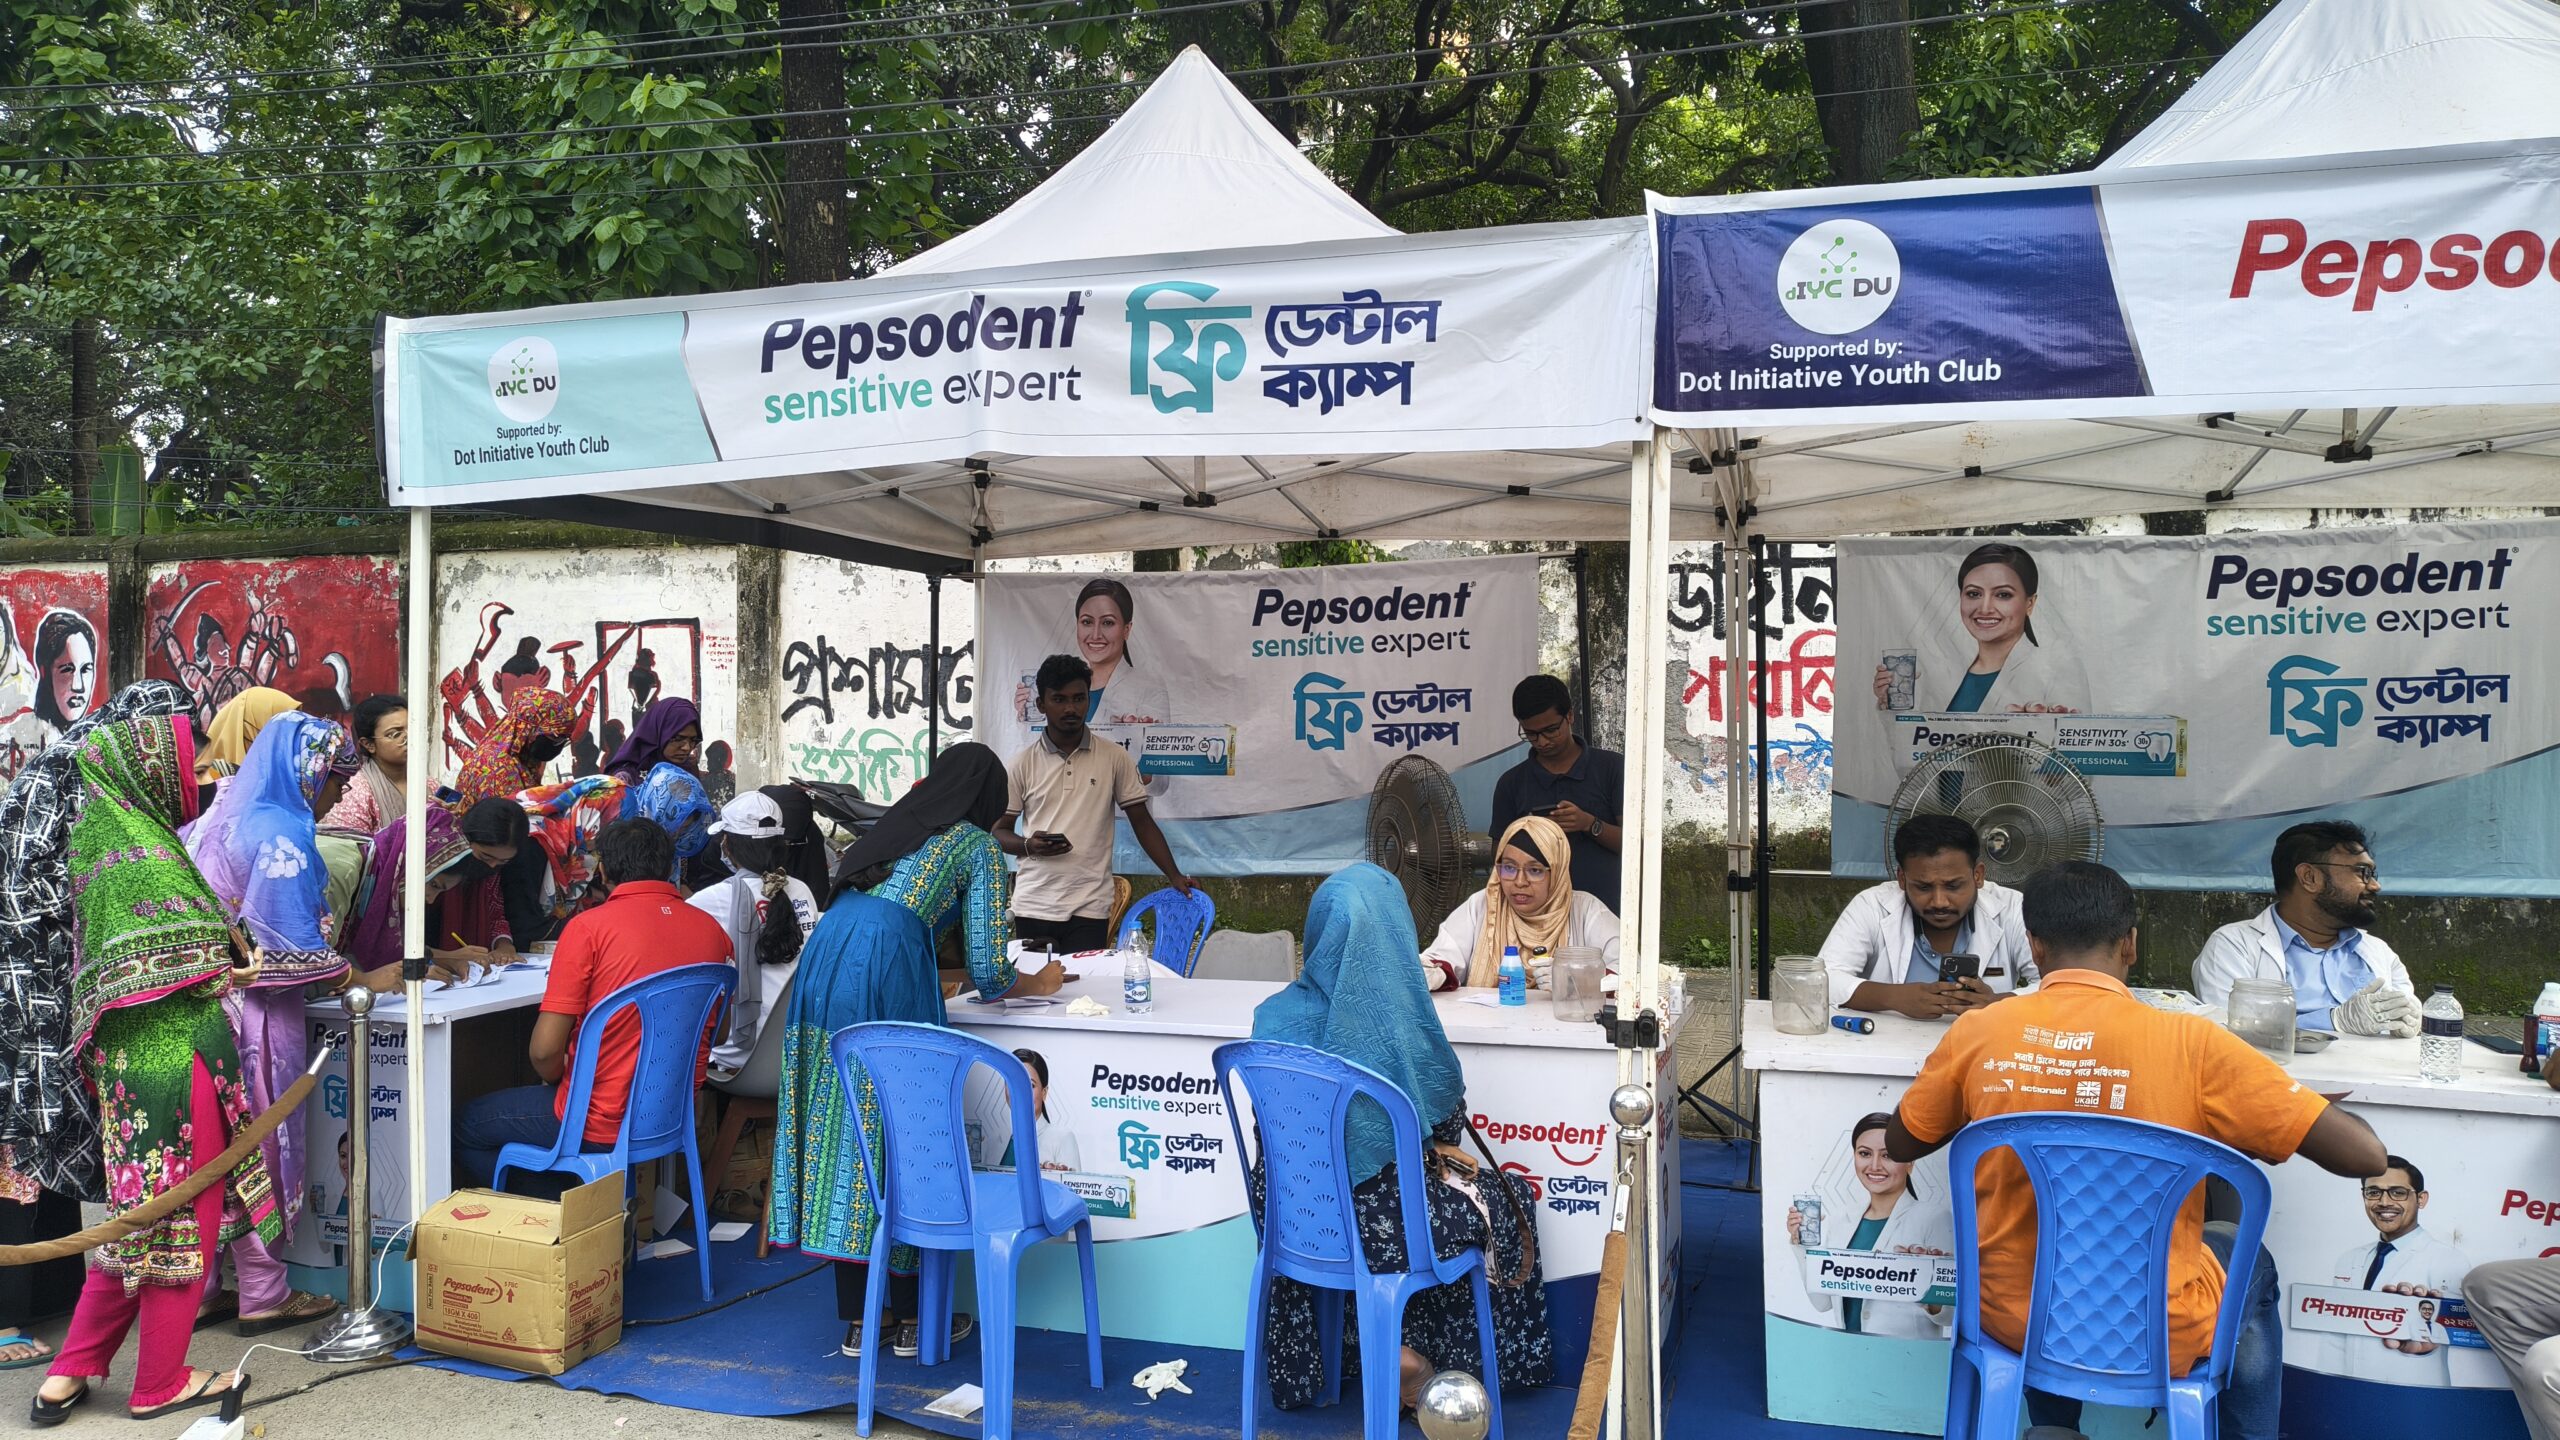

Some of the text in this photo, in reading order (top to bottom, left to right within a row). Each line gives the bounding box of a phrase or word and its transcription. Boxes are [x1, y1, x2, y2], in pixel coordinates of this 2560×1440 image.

[2230, 217, 2560, 312] Pepso
[1853, 276, 1893, 299] DU
[761, 291, 1085, 381] Pepsodent
[1126, 281, 1442, 414] ফ্রি ডেন্টাল
[1769, 337, 1903, 364] Supported by:
[533, 376, 556, 393] DU
[1261, 360, 1415, 416] ক্যাম্প
[1679, 357, 2002, 394] Dot Initiative Youth Club
[764, 367, 1082, 425] sensitive expert
[496, 423, 562, 442] Supported by:
[453, 437, 609, 467] Dot Initiative Youth Club
[2206, 549, 2513, 609] Pepsodent
[1252, 582, 1471, 633] Pepsodent
[2207, 603, 2510, 638] sensitive expert
[1252, 628, 1470, 658] sensitive expert
[1293, 671, 1472, 750] ফ্রি ডেন্টাল
[2267, 655, 2368, 749] ফ্রি
[2377, 668, 2510, 712] ডেন্টাল
[1372, 720, 1459, 751] ক্যাম্প
[2059, 728, 2128, 738] SENSITIVITY
[2059, 738, 2093, 747] RELIEF
[2095, 738, 2106, 747] IN
[2377, 713, 2492, 749] ক্যাম্প
[2014, 1052, 2034, 1063] সবাই
[2036, 1054, 2056, 1065] মিলে
[2058, 1059, 2077, 1068] সবার
[2020, 1085, 2067, 1095] actionaid
[1091, 1095, 1223, 1117] sensitive expert
[1472, 1114, 1607, 1144] Pepsodent
[1118, 1120, 1223, 1169] ফ্রি ডেন্টাল
[1165, 1155, 1216, 1174] ক্যাম্প
[1548, 1176, 1608, 1196] ডেন্টাল
[1548, 1197, 1601, 1216] ক্যাম্প
[444, 1277, 495, 1296] Pepsodent
[1821, 1260, 1918, 1283] Pepsodent
[1821, 1280, 1917, 1296] sensitive expert
